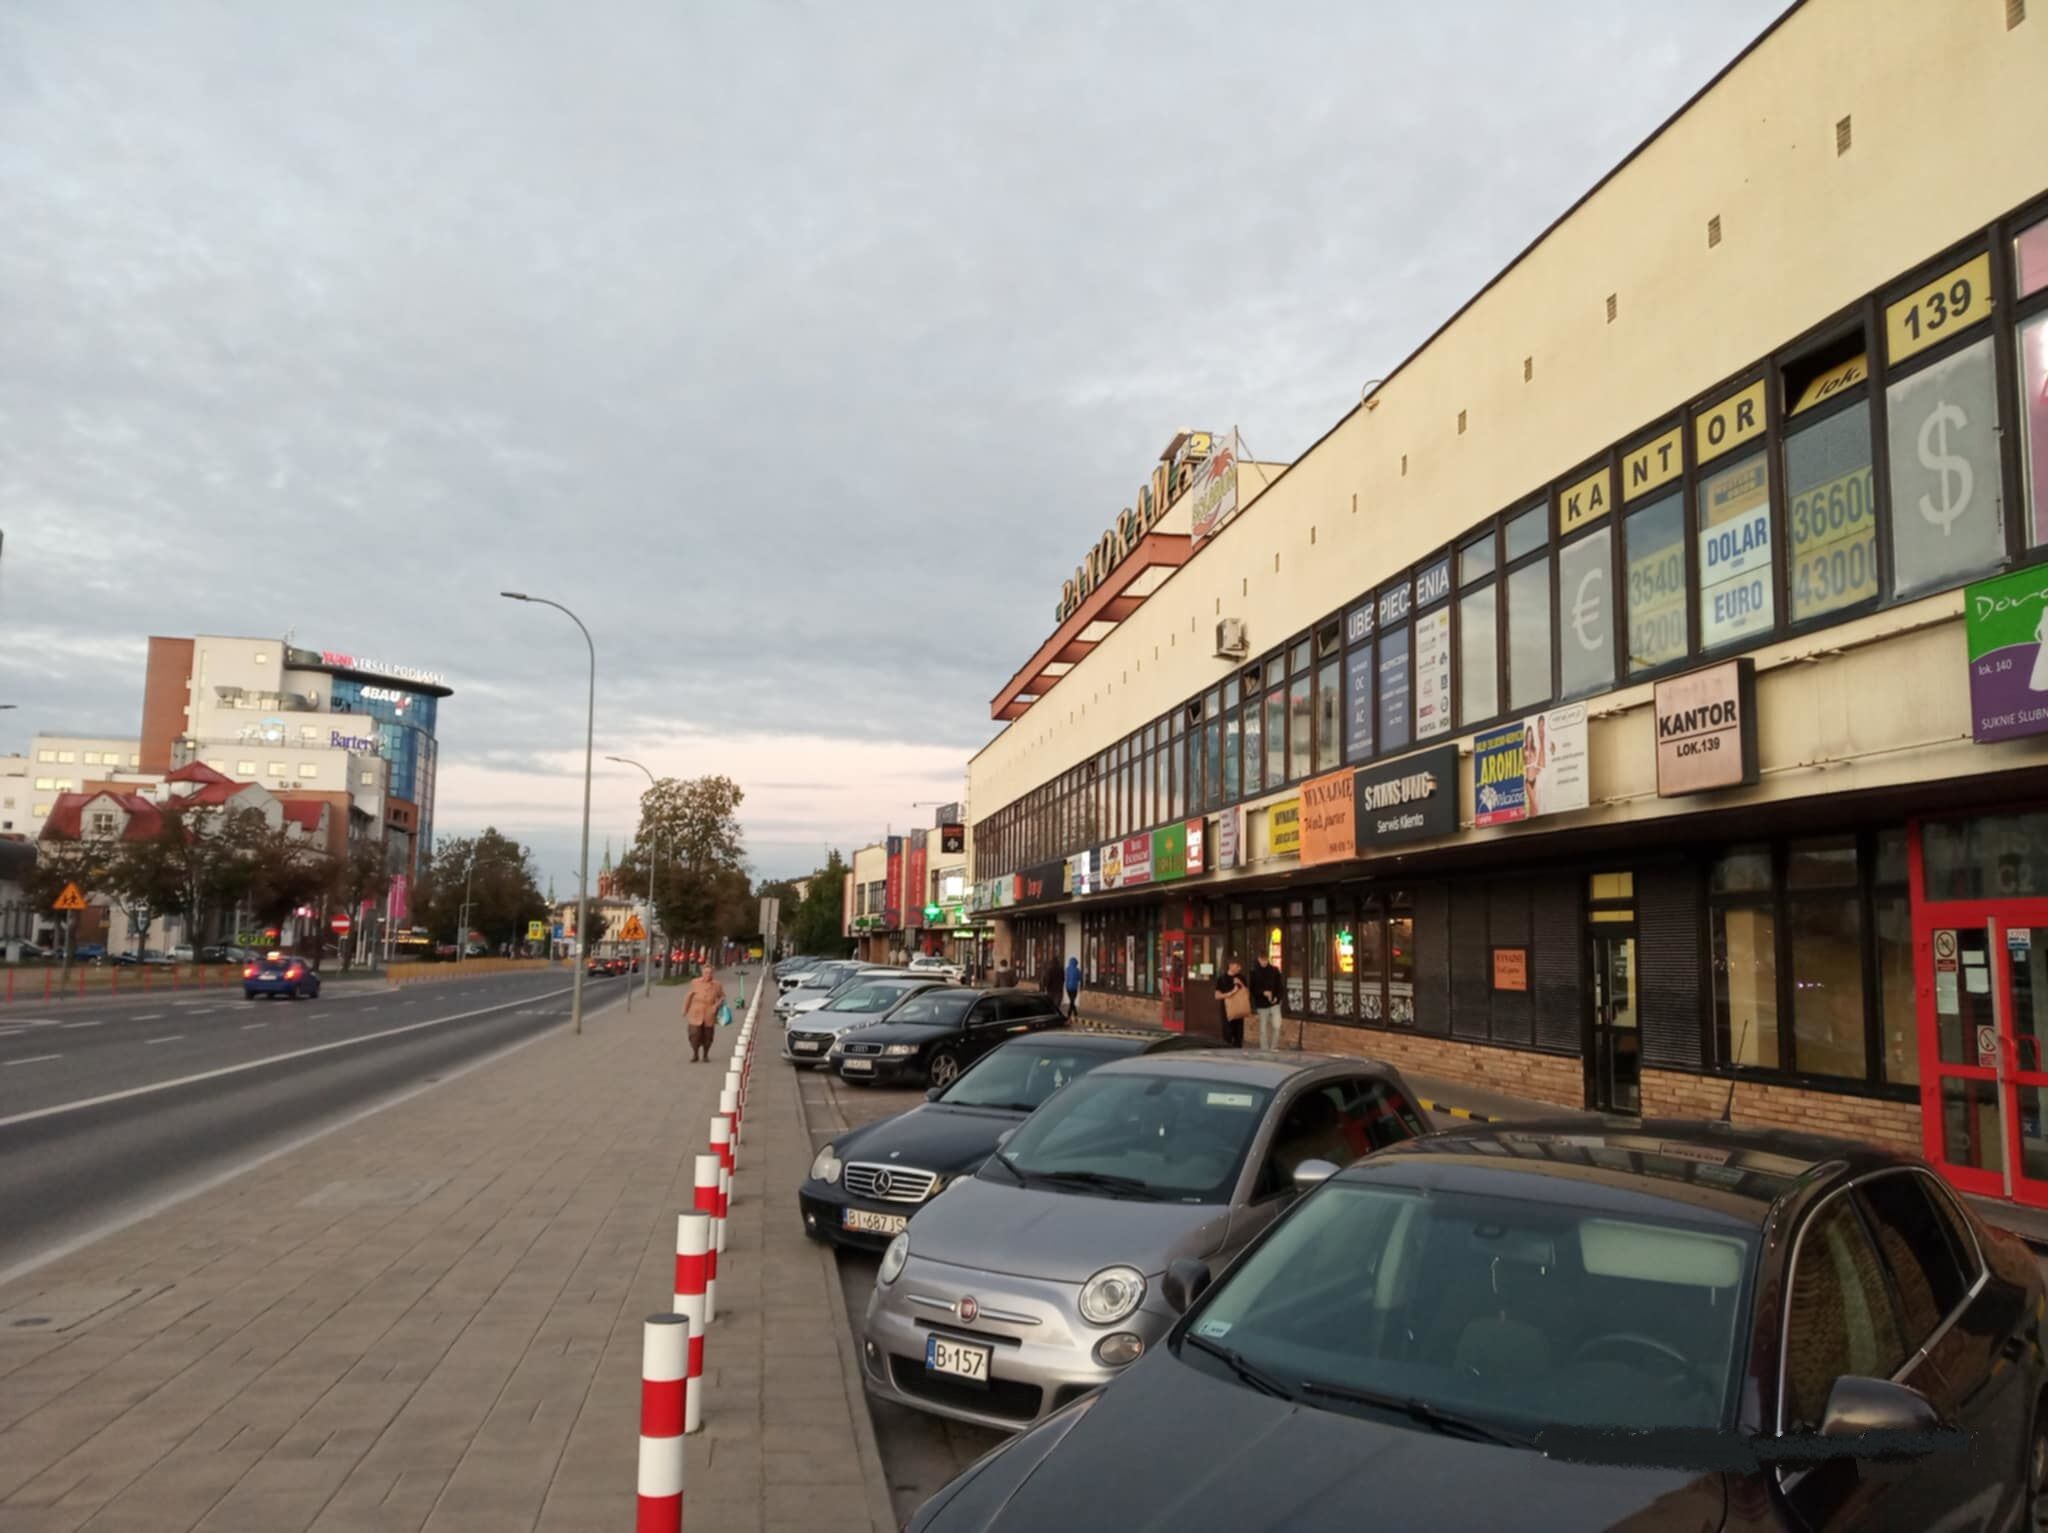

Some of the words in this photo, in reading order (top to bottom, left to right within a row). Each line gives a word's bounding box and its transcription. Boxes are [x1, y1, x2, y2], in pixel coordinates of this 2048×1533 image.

[1815, 366, 1862, 398] lok.
[1903, 279, 1972, 341] 139
[1057, 458, 1194, 622] PANORAMA
[1707, 517, 1768, 567] DOLAR
[1714, 580, 1764, 624] EURO
[360, 685, 401, 703] 4BAU
[1659, 700, 1737, 738] KANTOR
[1981, 712, 2016, 730] SUKNIE
[331, 730, 369, 749] Barter
[1676, 737, 1721, 758] LOK.139
[1365, 771, 1434, 811] SAMSUNG
